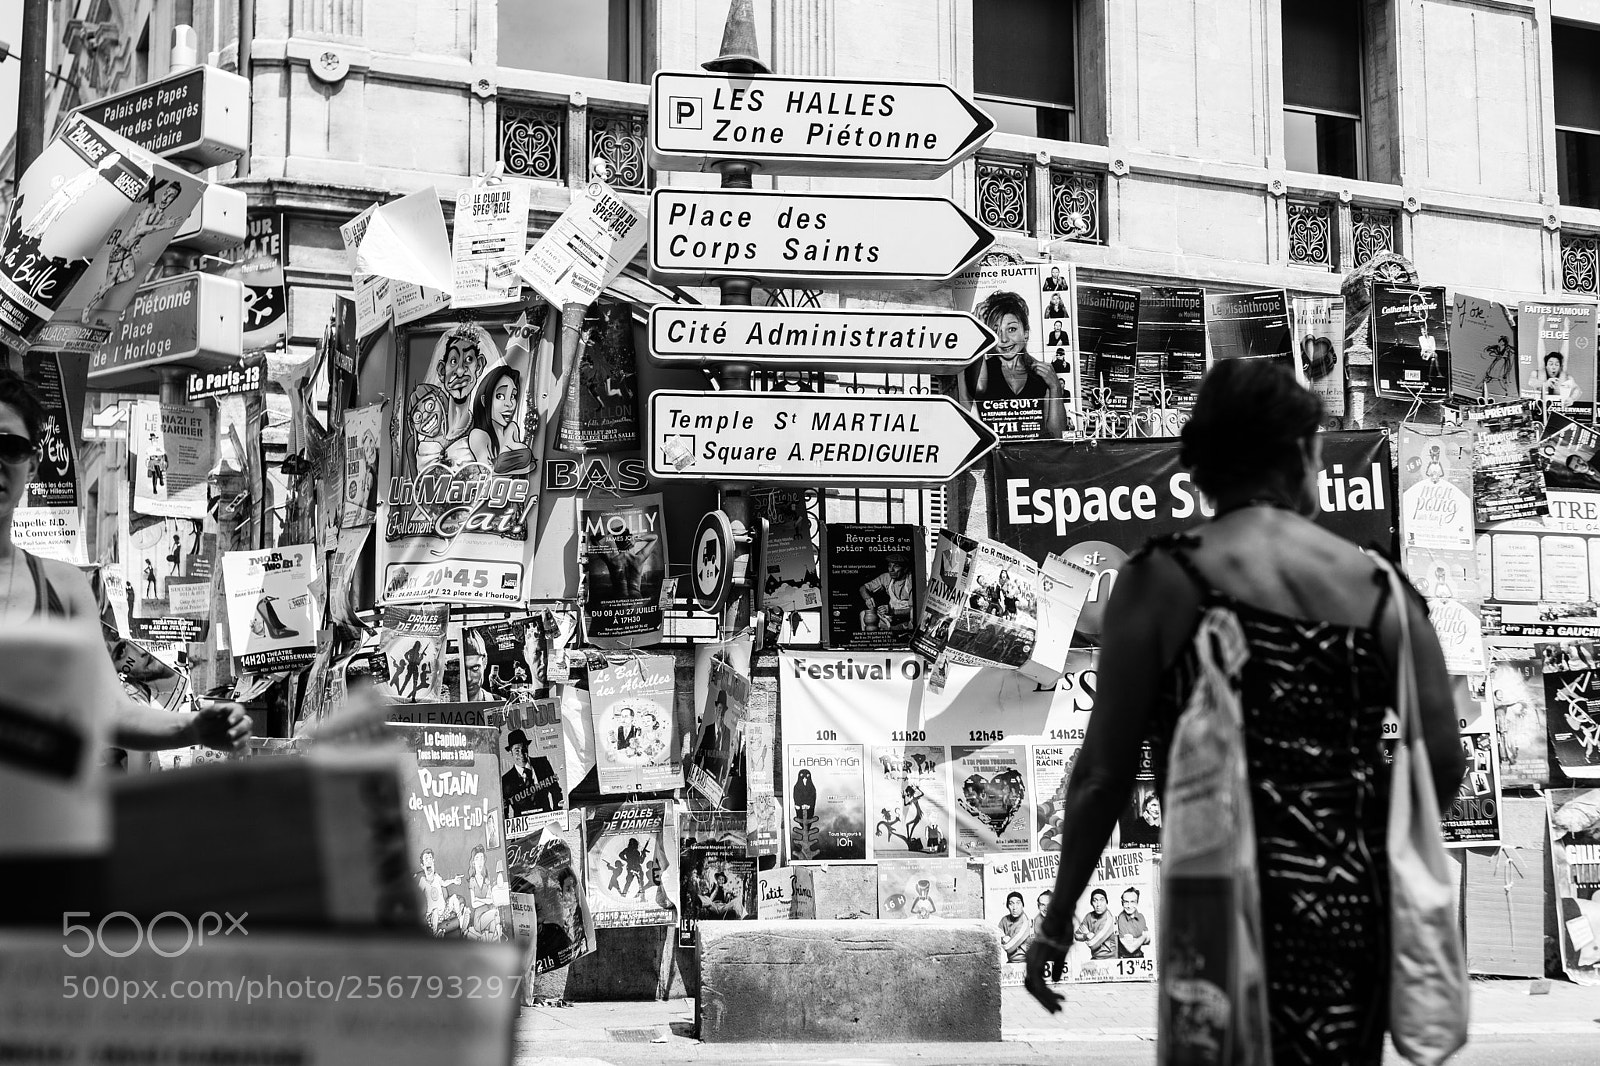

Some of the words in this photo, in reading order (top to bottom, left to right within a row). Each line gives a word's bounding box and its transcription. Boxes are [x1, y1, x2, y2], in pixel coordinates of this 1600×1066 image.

[103, 101, 134, 124] Palais
[136, 94, 153, 114] des
[157, 84, 188, 107] Papes
[713, 88, 764, 112] LES
[786, 91, 895, 117] HALLES
[135, 115, 152, 134] des
[156, 102, 199, 129] Congrès
[677, 102, 694, 124] P
[713, 119, 784, 144] Zone
[806, 122, 937, 150] Piétonne
[70, 126, 108, 162] PALACE
[474, 194, 480, 204] LE
[483, 192, 500, 203] CLOU
[502, 191, 511, 200] DU
[601, 194, 612, 204] LE
[609, 200, 629, 219] CLOU
[625, 214, 638, 228] DU
[669, 203, 752, 228] Place
[778, 207, 827, 230] des
[669, 234, 757, 264] Corps
[783, 237, 879, 262] Saints
[12, 254, 57, 298] Bulle
[1001, 267, 1037, 277] RUATTI
[968, 279, 990, 287] Woman
[135, 288, 191, 319] Piétonne
[1524, 305, 1552, 314] FAITES
[1553, 307, 1590, 316] L'AMOUR
[122, 321, 153, 342] Place
[667, 320, 728, 345] Cité
[745, 322, 959, 349] Administrative
[1539, 330, 1570, 340] BELGE
[93, 351, 107, 368] de
[113, 337, 171, 365] l'Horloge
[190, 374, 203, 393] Le
[206, 366, 260, 390] Paris-13
[983, 400, 1008, 410] C'est
[1010, 399, 1031, 409] QUI
[162, 415, 187, 425] NAZI
[190, 417, 202, 427] ET
[669, 409, 753, 433] Temple
[774, 411, 797, 430] St
[811, 412, 920, 433] MARTIAL
[703, 441, 777, 463] Square
[546, 458, 649, 491] BAS
[388, 476, 414, 504] Un
[415, 473, 529, 508] Mariage
[1007, 478, 1157, 537] Espace
[1317, 462, 1385, 512] tial
[1548, 500, 1596, 519] TRE
[12, 518, 47, 529] hapelle
[26, 528, 76, 537] Conversion
[585, 511, 657, 536] MOLLY
[845, 533, 895, 543] Rêveries
[836, 545, 864, 553] potier
[869, 544, 911, 552] solitaire
[423, 567, 489, 588] 20h45
[930, 577, 966, 606] TAIWAN
[635, 605, 657, 615] JUILLET
[620, 616, 641, 624] 17H30
[1522, 626, 1543, 635] rue
[1545, 624, 1555, 635] à
[1557, 626, 1600, 637] GAUCH
[240, 654, 266, 667] 14H20
[276, 652, 317, 661] L'OBSERVANC
[593, 670, 610, 683] Le
[614, 666, 640, 680] Bal
[794, 659, 891, 681] Festival
[596, 686, 615, 697] des
[620, 674, 672, 693] Abeilles
[440, 711, 485, 727] MAGN
[424, 732, 433, 747] Le
[434, 731, 467, 748] Capitole
[816, 730, 837, 741] 10h
[891, 730, 926, 742] 11h20
[969, 729, 1004, 742] 12h45
[1050, 729, 1085, 741] 14h25
[431, 750, 440, 760] les
[1036, 759, 1064, 767] RACINE
[408, 793, 423, 810] de
[1442, 798, 1497, 820] ASINO
[506, 817, 529, 835] PARIS
[836, 837, 853, 847] 10h
[759, 879, 784, 901] Petit
[1117, 959, 1153, 976] 13H45
